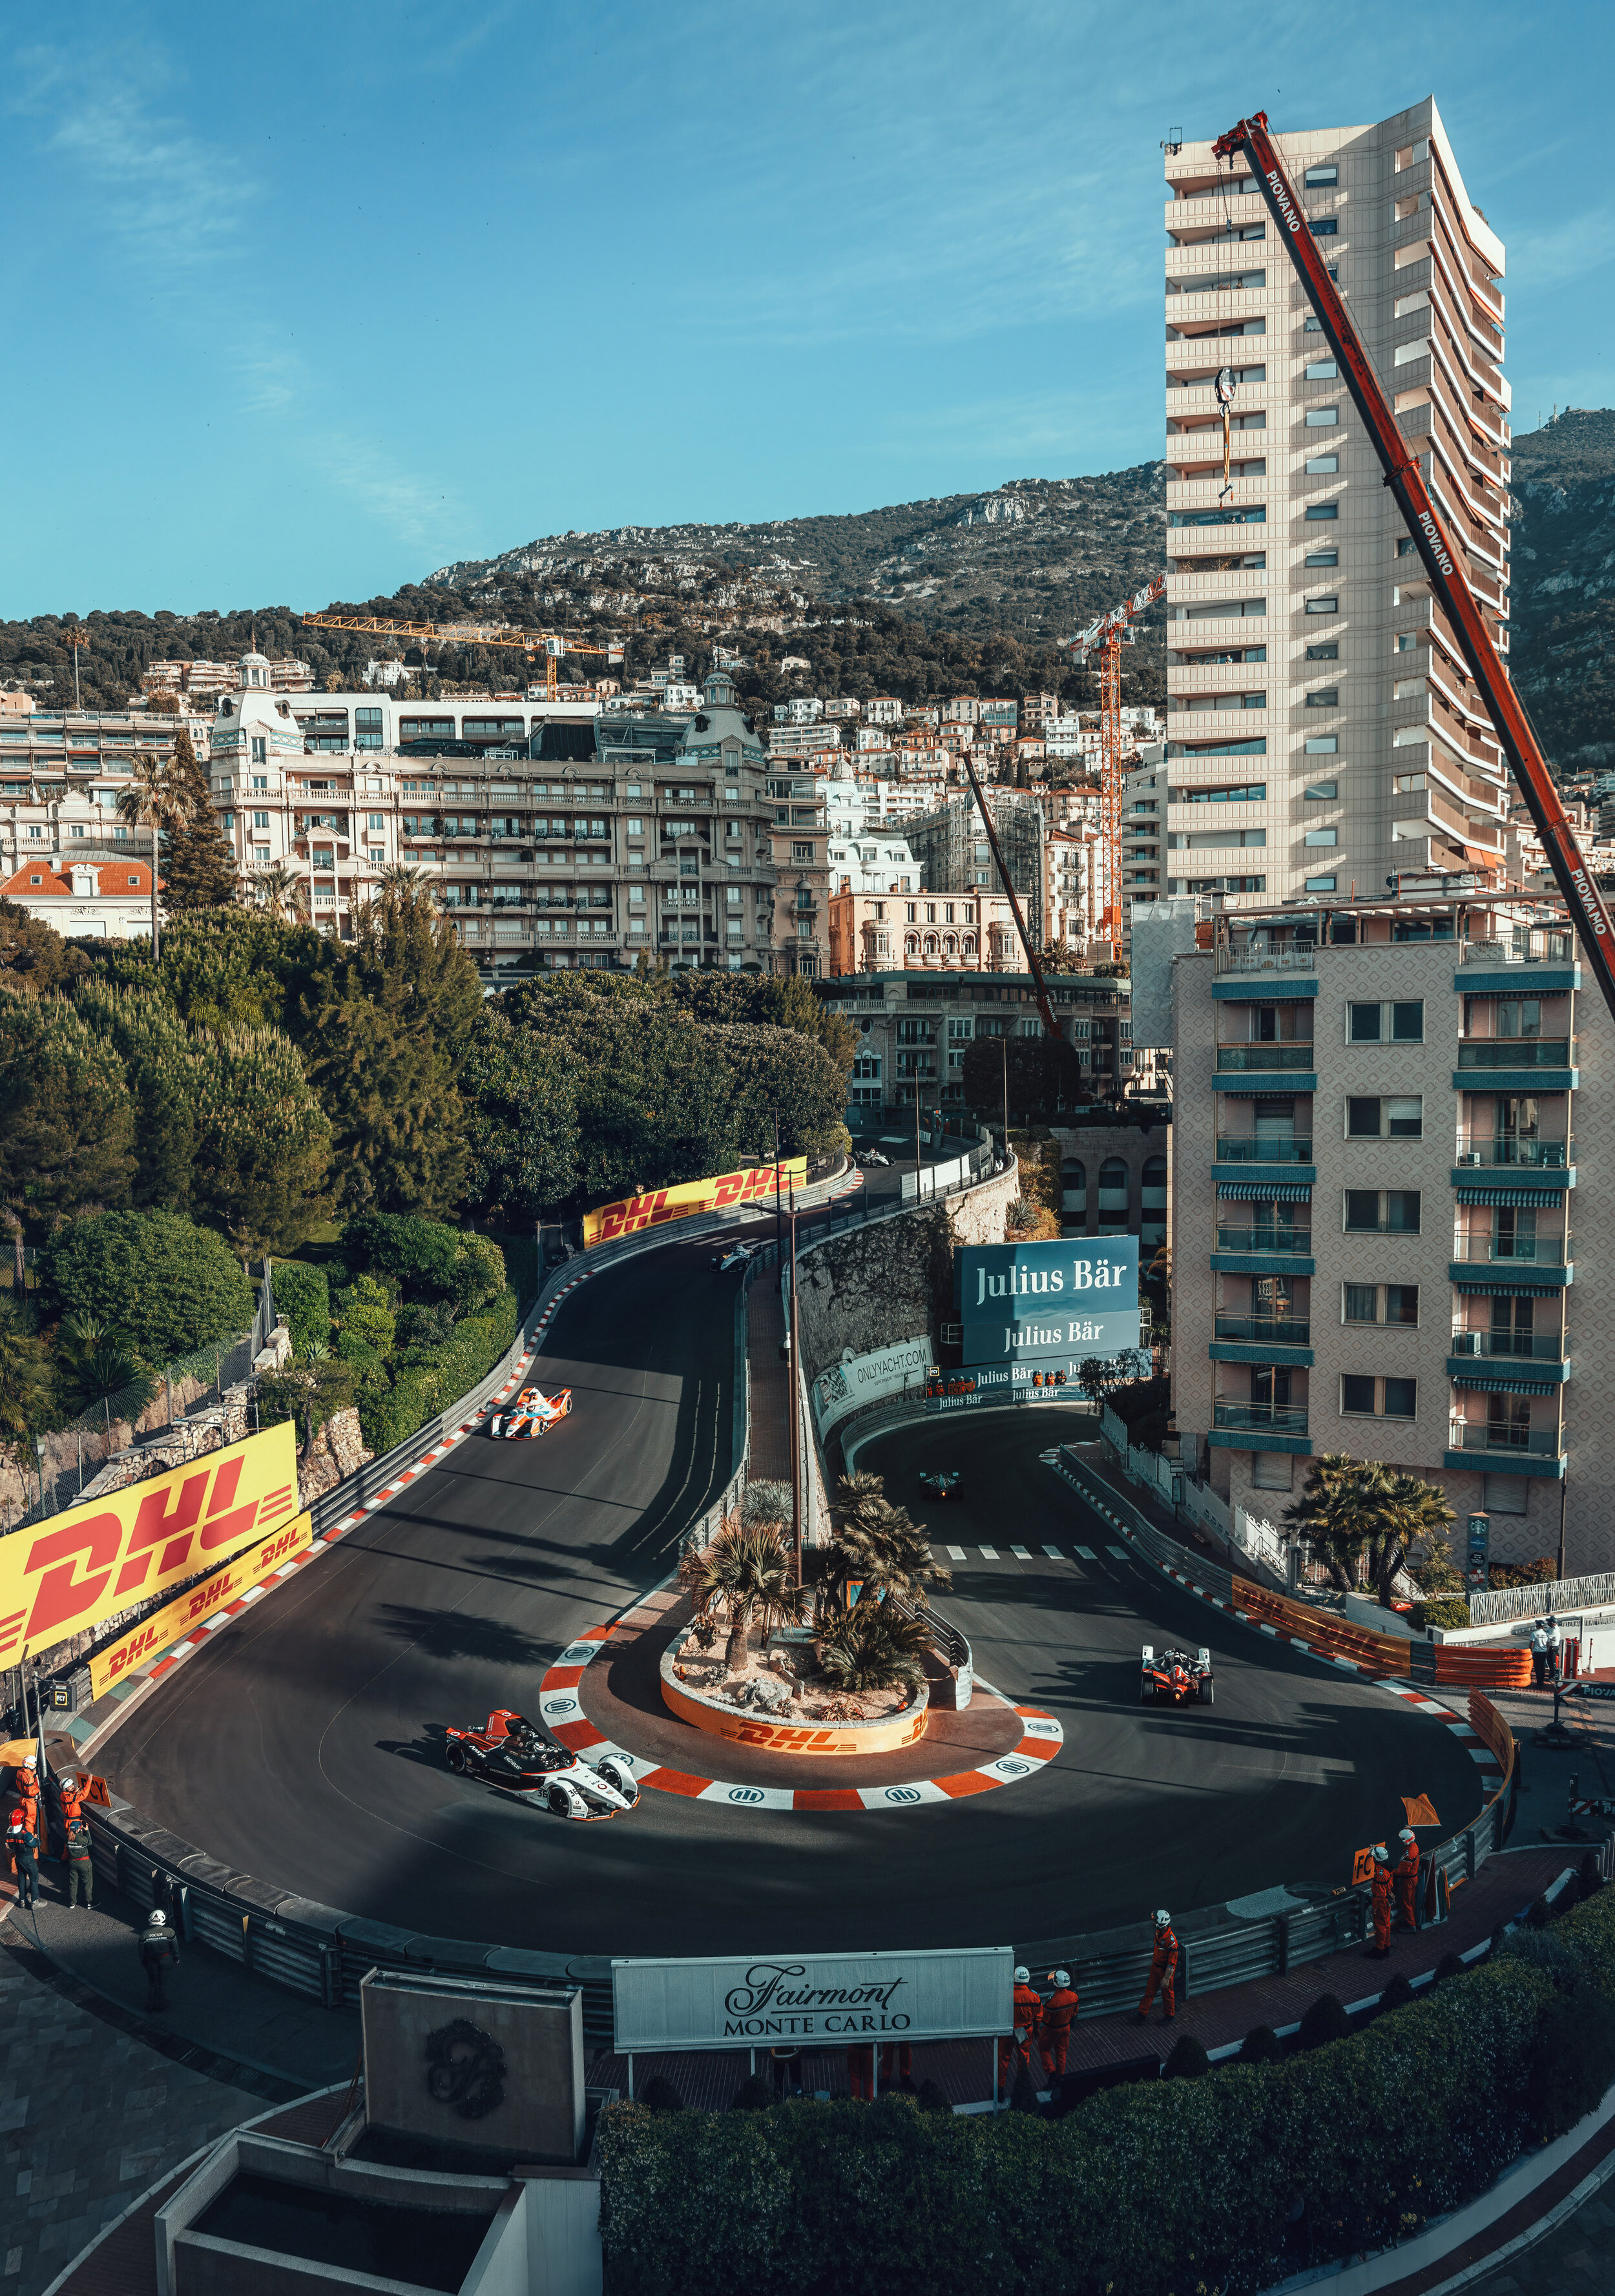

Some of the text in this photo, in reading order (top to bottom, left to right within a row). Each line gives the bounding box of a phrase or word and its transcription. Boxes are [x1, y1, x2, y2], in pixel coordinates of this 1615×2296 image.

[1266, 170, 1300, 233] PIOVANO
[1418, 510, 1453, 575] PIOVANO
[1571, 869, 1607, 936] PIOVANO
[1022, 925, 1030, 945] PIOVANO
[1045, 995, 1057, 1023] PIOVANO
[713, 1163, 791, 1207] DHL
[601, 1191, 674, 1240] DHL
[976, 1259, 1127, 1305] Julius Bär
[1004, 1321, 1105, 1353] Julius Bär
[857, 1349, 927, 1383] ONLYYACHT.COM
[977, 1367, 1033, 1388] Julius Bär
[939, 1394, 983, 1411] Julius Bär
[1013, 1387, 1059, 1401] Julius Bär
[23, 1454, 260, 1641] DHL
[260, 1527, 300, 1570] DHL
[189, 1572, 235, 1620] DHL
[108, 1625, 160, 1679] DHL
[1316, 1617, 1386, 1662] DHL
[468, 1744, 486, 1758] Ansys
[736, 1721, 839, 1752] DHL
[489, 1768, 520, 1779] PORSCHE
[537, 1789, 548, 1798] 36
[724, 1963, 908, 2018] Fairmont
[723, 2013, 911, 2037] MONTE CARLO
